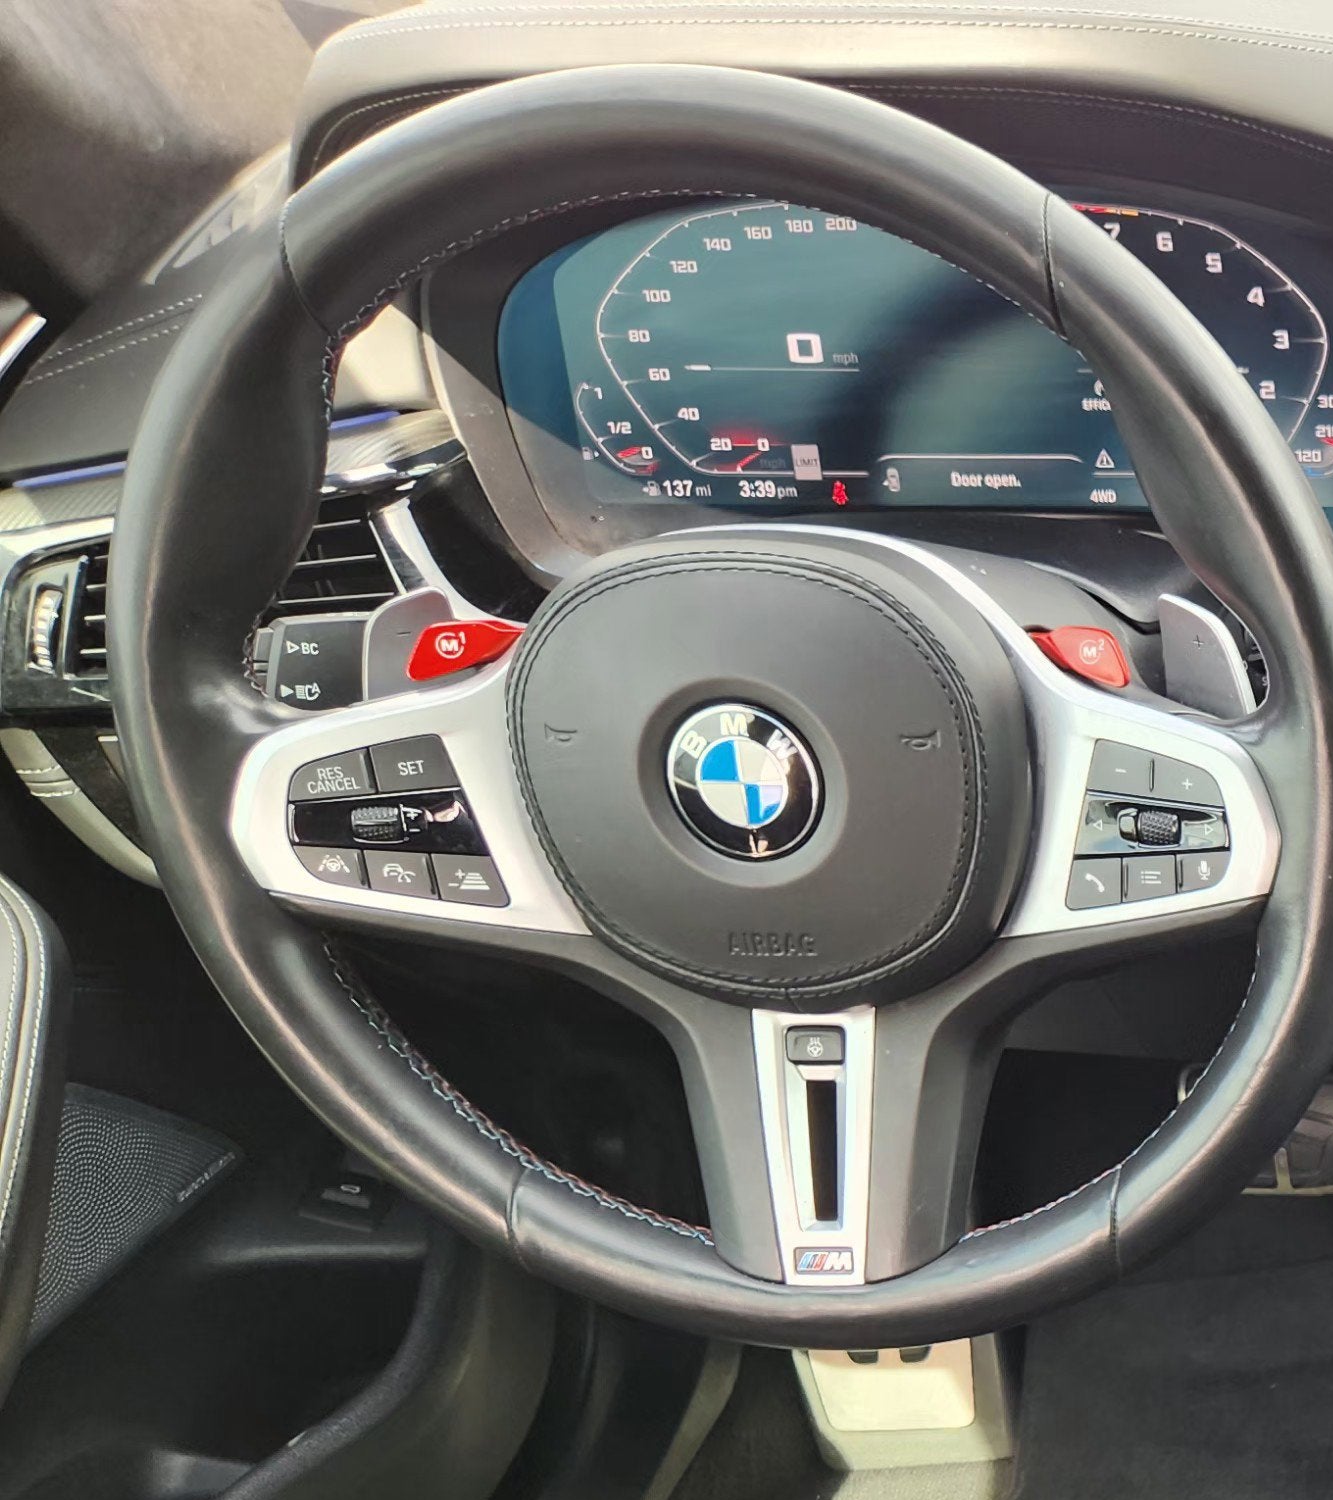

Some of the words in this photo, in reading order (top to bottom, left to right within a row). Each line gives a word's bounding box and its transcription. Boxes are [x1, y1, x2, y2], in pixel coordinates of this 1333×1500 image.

[785, 219, 814, 234] 180
[825, 216, 857, 232] 200
[1103, 221, 1121, 240] 7
[744, 225, 773, 240] 160
[703, 237, 731, 252] 140
[1156, 231, 1174, 252] 6
[670, 260, 698, 275] 120
[1205, 252, 1223, 274] 5
[642, 289, 671, 303] 100
[1246, 286, 1265, 307] 4
[628, 329, 650, 343] 80
[1272, 329, 1290, 350] 3
[786, 333, 824, 364] 0
[833, 352, 859, 366] mph
[648, 368, 671, 382] 60
[1259, 380, 1276, 400] 2
[677, 407, 700, 421] 40
[607, 420, 632, 435] 1/2
[710, 437, 733, 451] 20
[757, 437, 770, 451] 0
[640, 446, 653, 459] 0
[1294, 448, 1322, 463] 120
[795, 457, 818, 467] LIMIT
[951, 471, 982, 487] Door
[984, 473, 1021, 490] open.
[662, 479, 693, 498] 137
[695, 484, 712, 497] mi
[1090, 488, 1117, 504] 4WD
[301, 642, 320, 656] BC
[680, 713, 800, 760] BMW
[317, 766, 344, 780] RES
[398, 760, 424, 776] SET
[307, 777, 361, 794] CANCEL
[728, 931, 818, 957] AIRBAG
